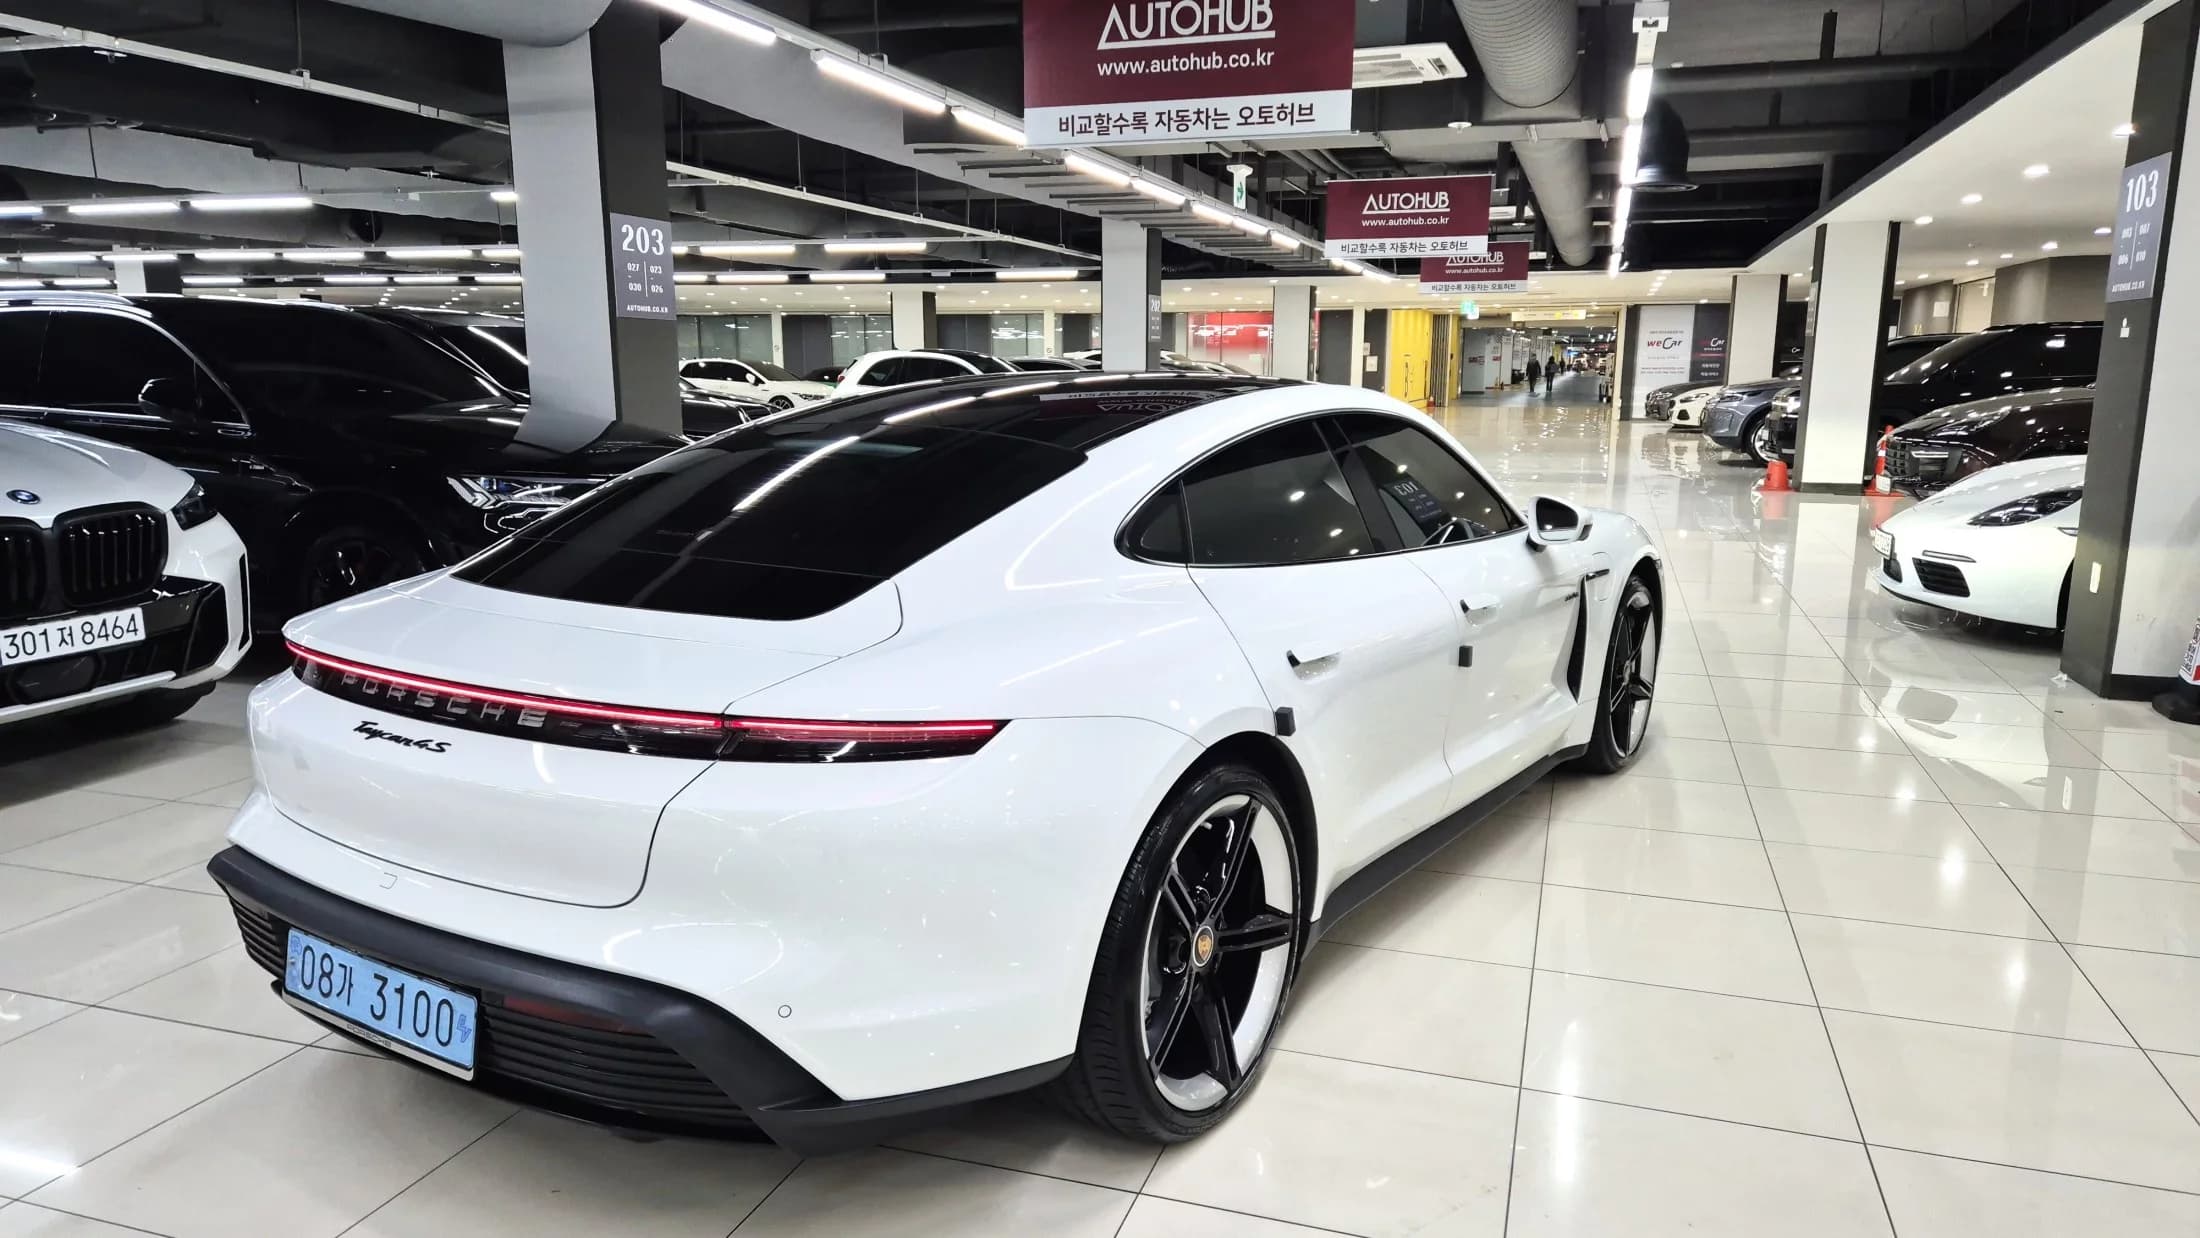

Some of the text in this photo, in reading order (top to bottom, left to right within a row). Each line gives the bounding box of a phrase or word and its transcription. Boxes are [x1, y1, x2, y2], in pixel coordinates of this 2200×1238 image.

[1097, 0, 1276, 50] AUTOHUB
[1097, 48, 1275, 76] www.autohub.co.kr
[1058, 102, 1316, 137] 비교할수록 자동차는 오토허브
[1362, 191, 1450, 214] AUTOHUB
[2125, 169, 2159, 213] 103
[1362, 215, 1450, 227] www.autohub.co.kr
[621, 224, 665, 256] 203
[1341, 240, 1469, 254] 비교할수록 자동차는 오토허브
[627, 262, 640, 272] 027
[649, 265, 662, 274] 023
[628, 282, 642, 292] 030
[626, 304, 668, 314] AUTOHUB.CO.KR
[81, 613, 139, 645] 8464
[341, 672, 548, 728] PORSCHE
[301, 945, 354, 1007] 08가
[370, 972, 454, 1047] 3100
